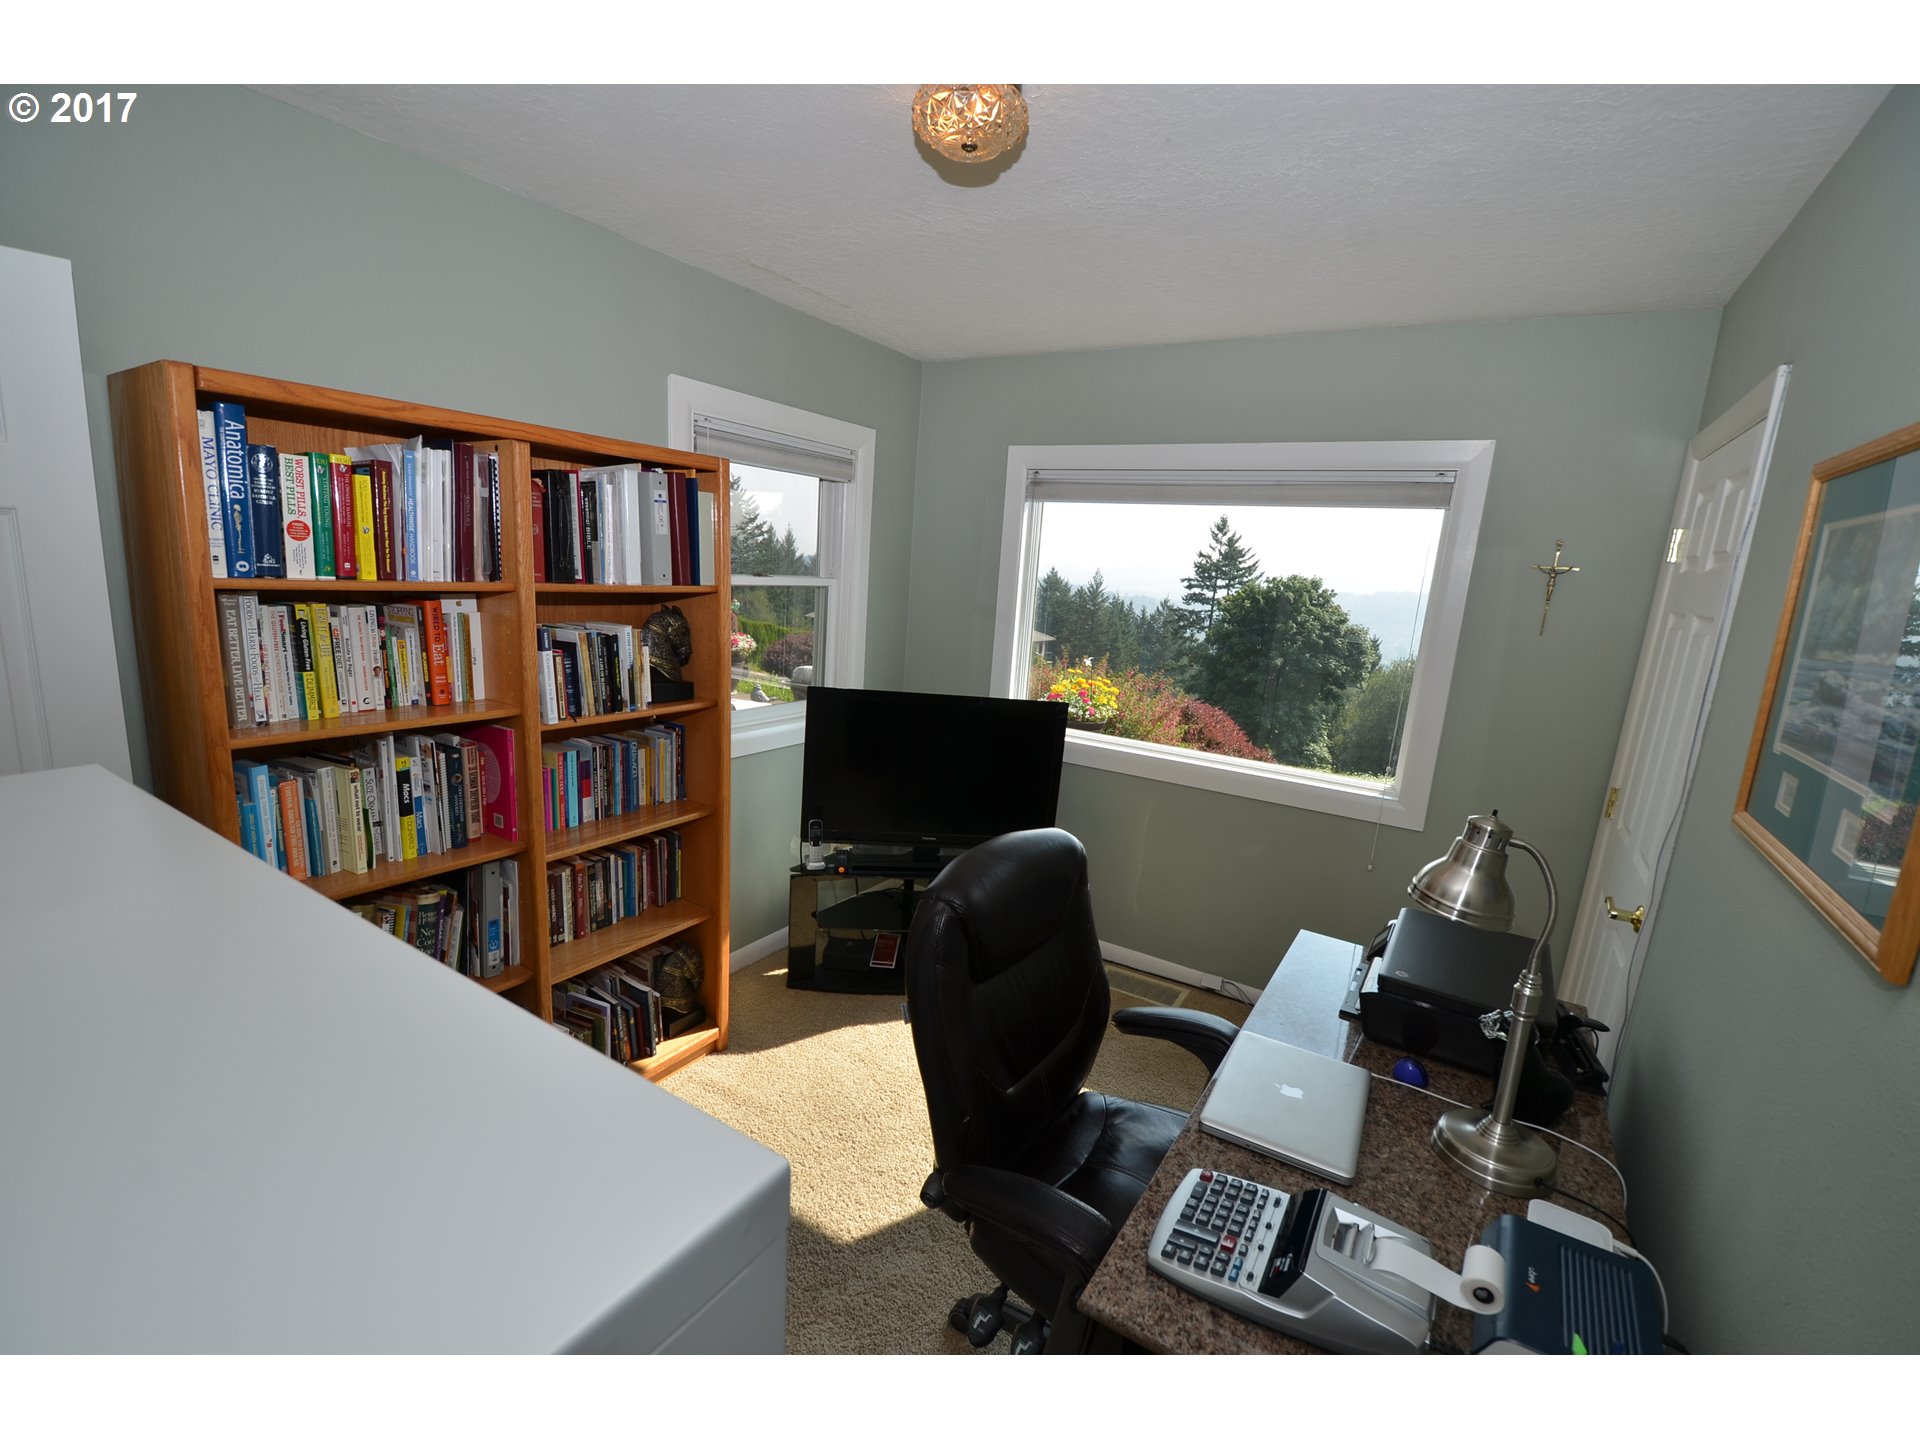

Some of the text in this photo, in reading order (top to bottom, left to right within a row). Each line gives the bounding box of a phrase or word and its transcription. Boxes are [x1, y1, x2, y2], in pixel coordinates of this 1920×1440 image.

[202, 437, 218, 480] MAYO
[225, 419, 247, 500] Anatomica
[294, 458, 305, 490] WORST
[284, 457, 296, 515] BEST PILLS
[296, 492, 306, 518] PILLS,
[321, 477, 330, 504] STAYING
[207, 484, 224, 531] CLINIC
[322, 505, 331, 528] YOUNG
[245, 597, 263, 703] FOODS HARM FOODS HEAL
[279, 614, 288, 653] FoodSmart
[300, 621, 312, 670] Living Gluten-Free
[432, 607, 445, 666] WIRED TO Eat
[226, 609, 247, 721] EAT BETTER, LIVE BETTER
[306, 677, 316, 711] DUMMIES
[365, 778, 377, 821] SUZE ORMAN
[402, 783, 411, 804] Macs
[468, 771, 478, 789] GERMAN
[470, 789, 479, 811] SHEPHERD
[416, 811, 424, 829] Macs
